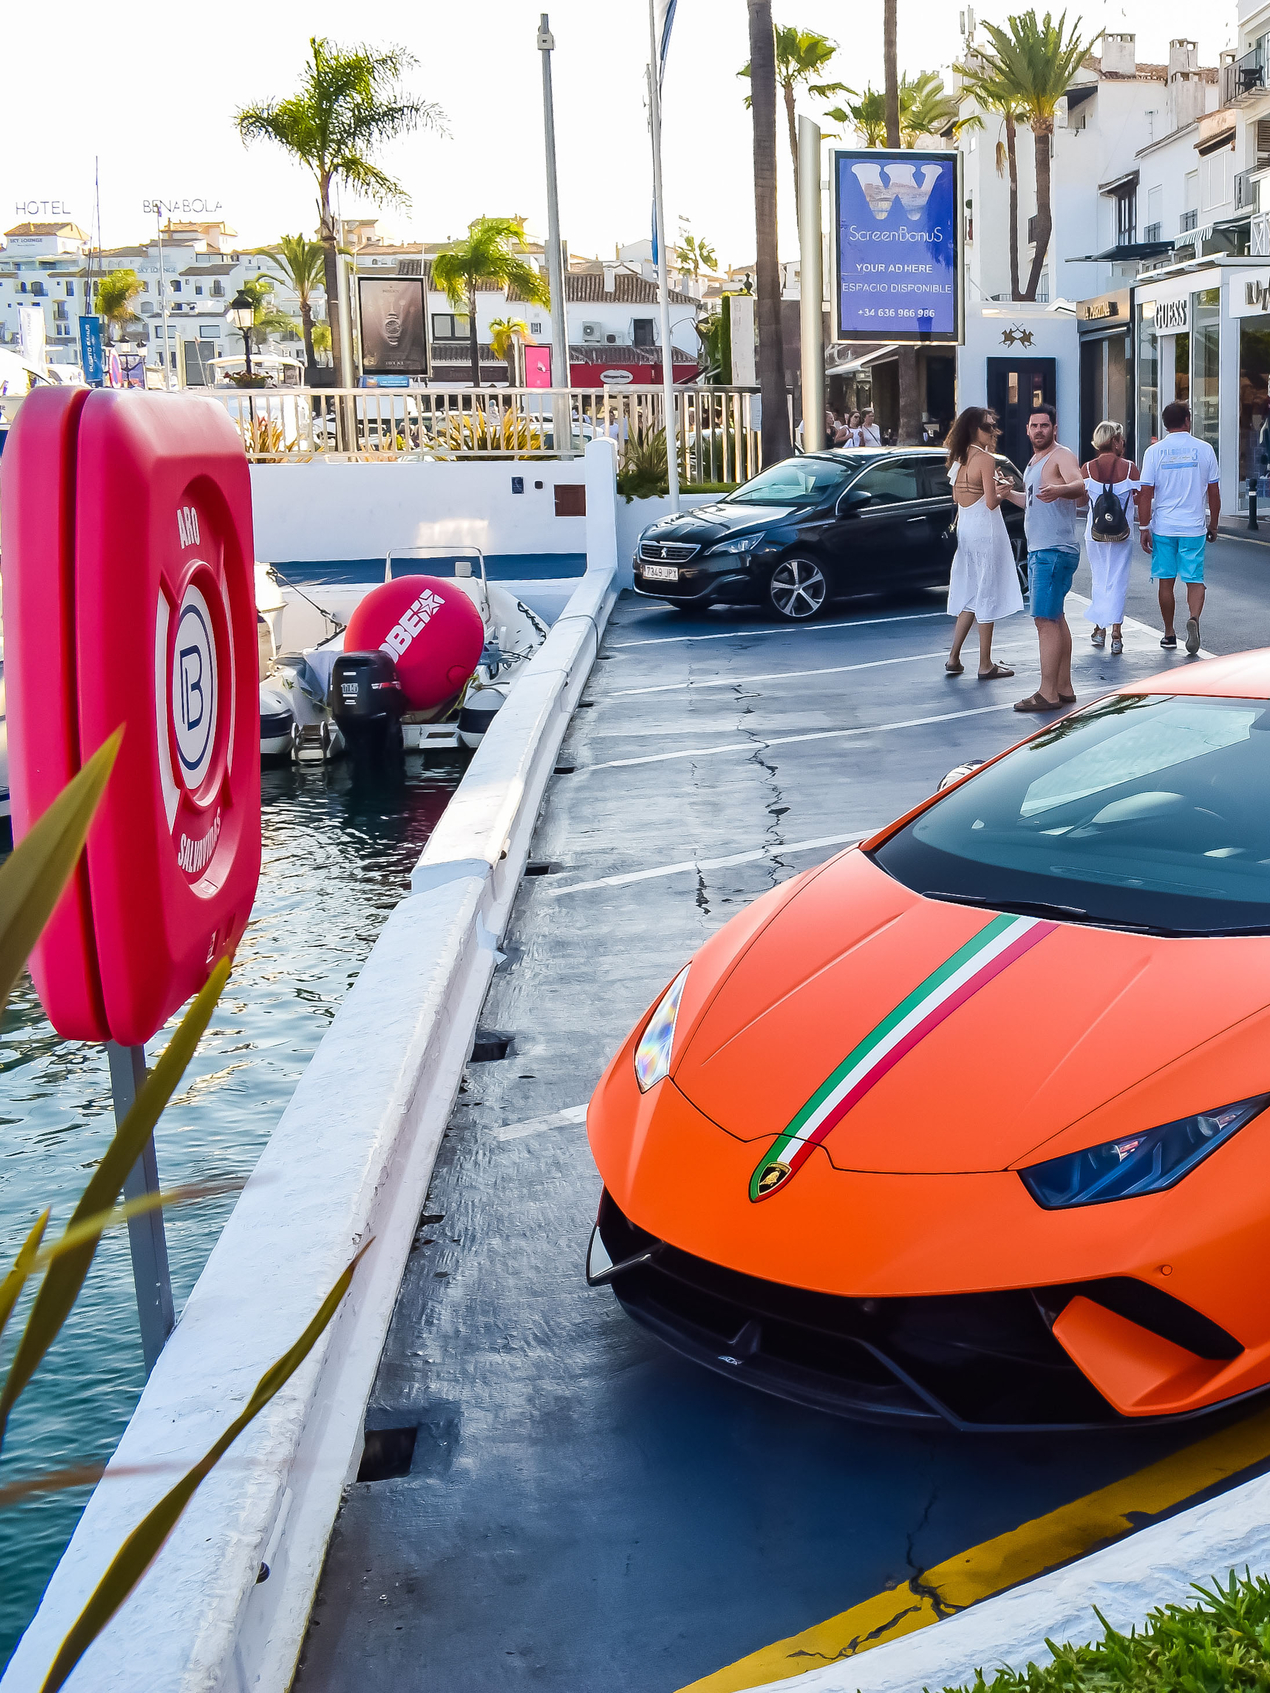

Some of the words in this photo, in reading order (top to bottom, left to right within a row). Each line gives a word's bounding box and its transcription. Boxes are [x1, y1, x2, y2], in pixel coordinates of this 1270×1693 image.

[15, 200, 72, 215] HOTEL
[856, 264, 886, 273] YOUR
[888, 264, 903, 273] AD
[904, 265, 933, 274] HERE
[842, 283, 888, 293] ESPACIO
[891, 283, 952, 294] DISPONIBLE
[858, 308, 875, 317] +34
[878, 308, 896, 317] 636
[898, 309, 916, 318] 966
[1155, 299, 1187, 329] GUESS
[177, 506, 200, 550] ARO
